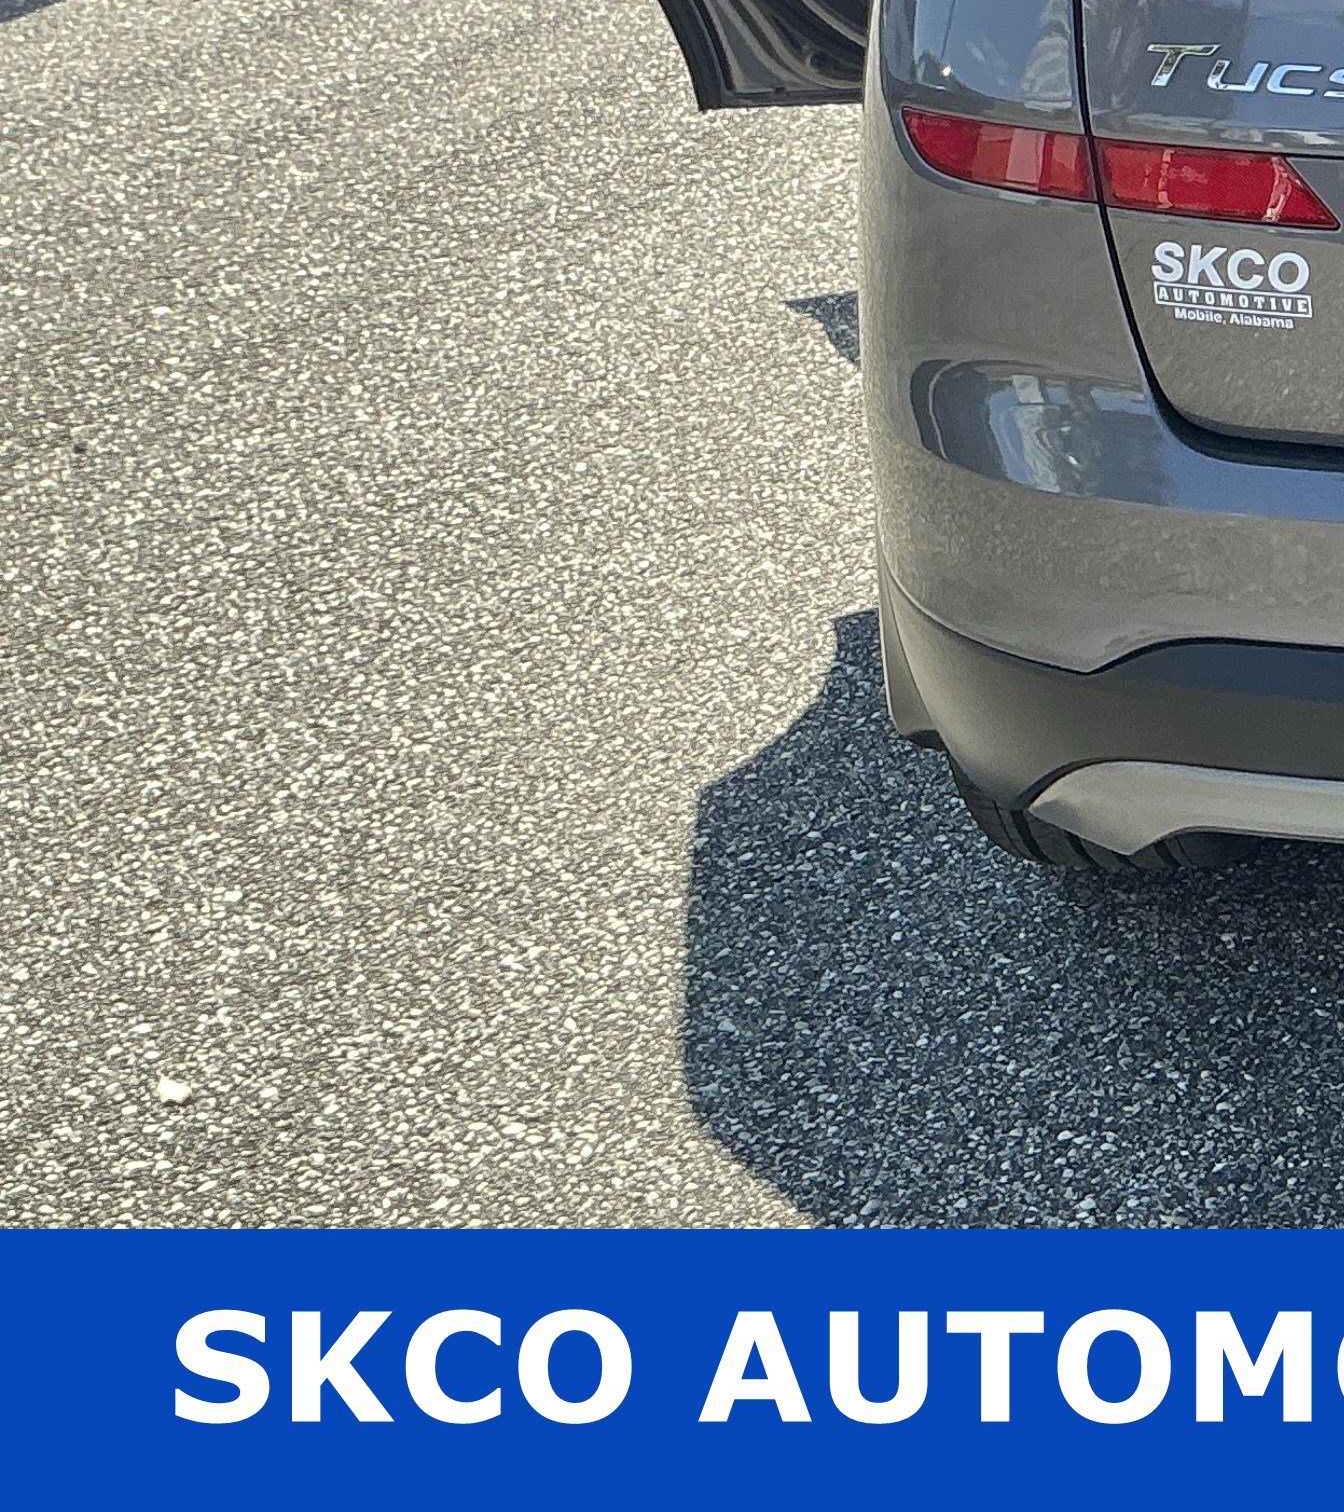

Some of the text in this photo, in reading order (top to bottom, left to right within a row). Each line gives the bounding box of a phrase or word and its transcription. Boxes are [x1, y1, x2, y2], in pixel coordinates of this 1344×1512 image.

[1151, 241, 1310, 293] SKCO
[1158, 286, 1309, 313] AUTOMOTIVE
[1174, 307, 1294, 330] Mobile, Alabama
